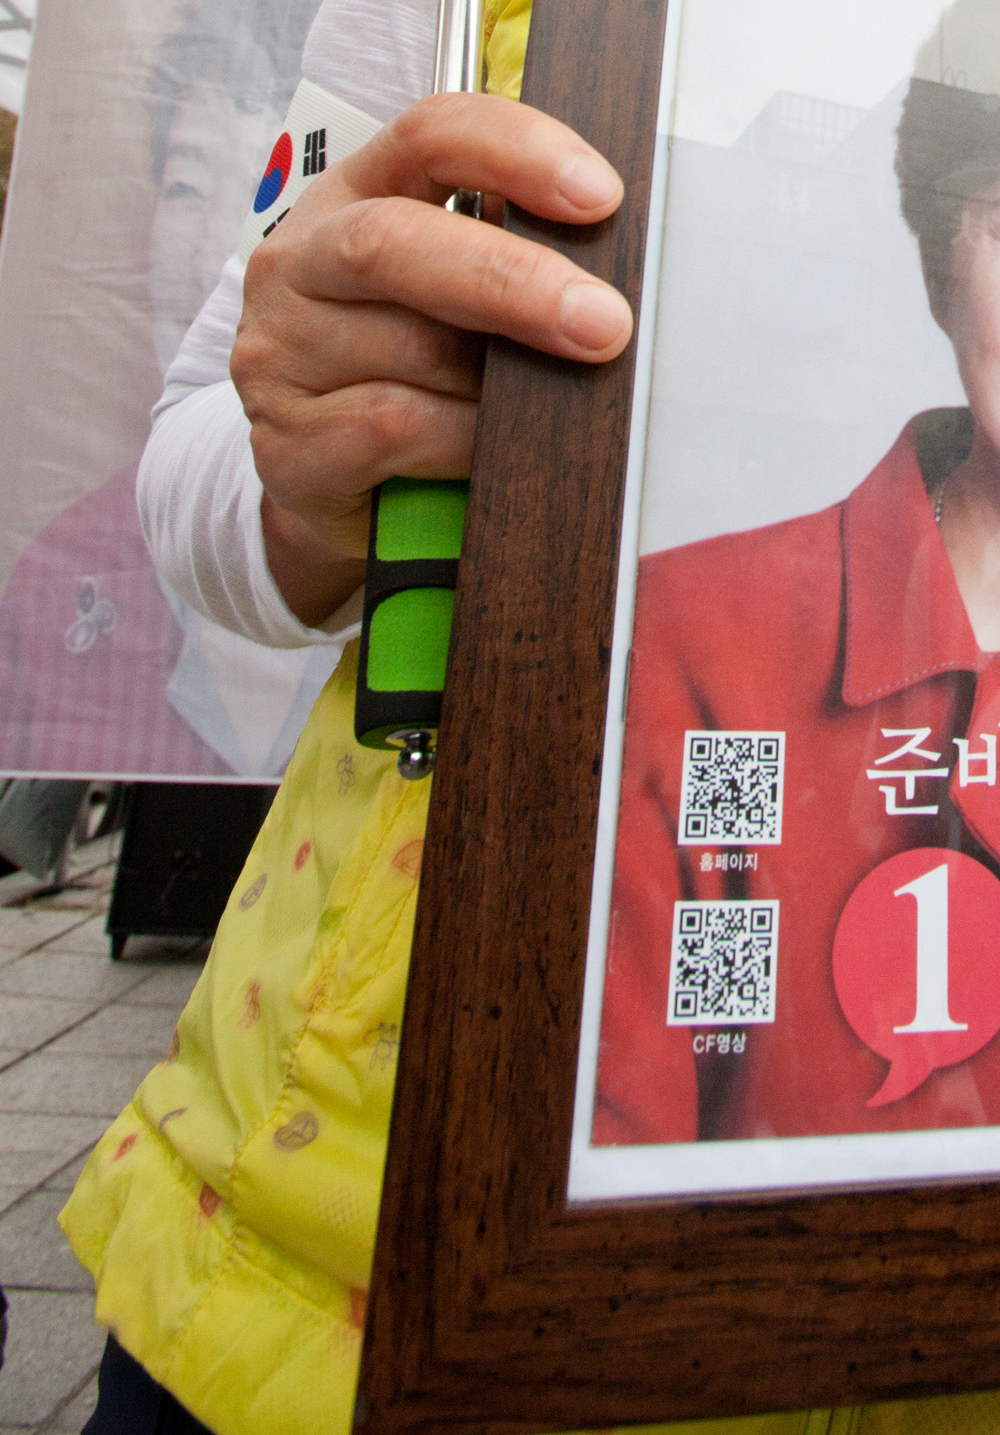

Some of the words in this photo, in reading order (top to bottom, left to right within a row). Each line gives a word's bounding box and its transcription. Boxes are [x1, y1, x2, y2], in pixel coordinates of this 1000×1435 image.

[699, 852, 759, 872] 홈페이지
[892, 863, 969, 1034] 1
[692, 1032, 747, 1054] CF영상
